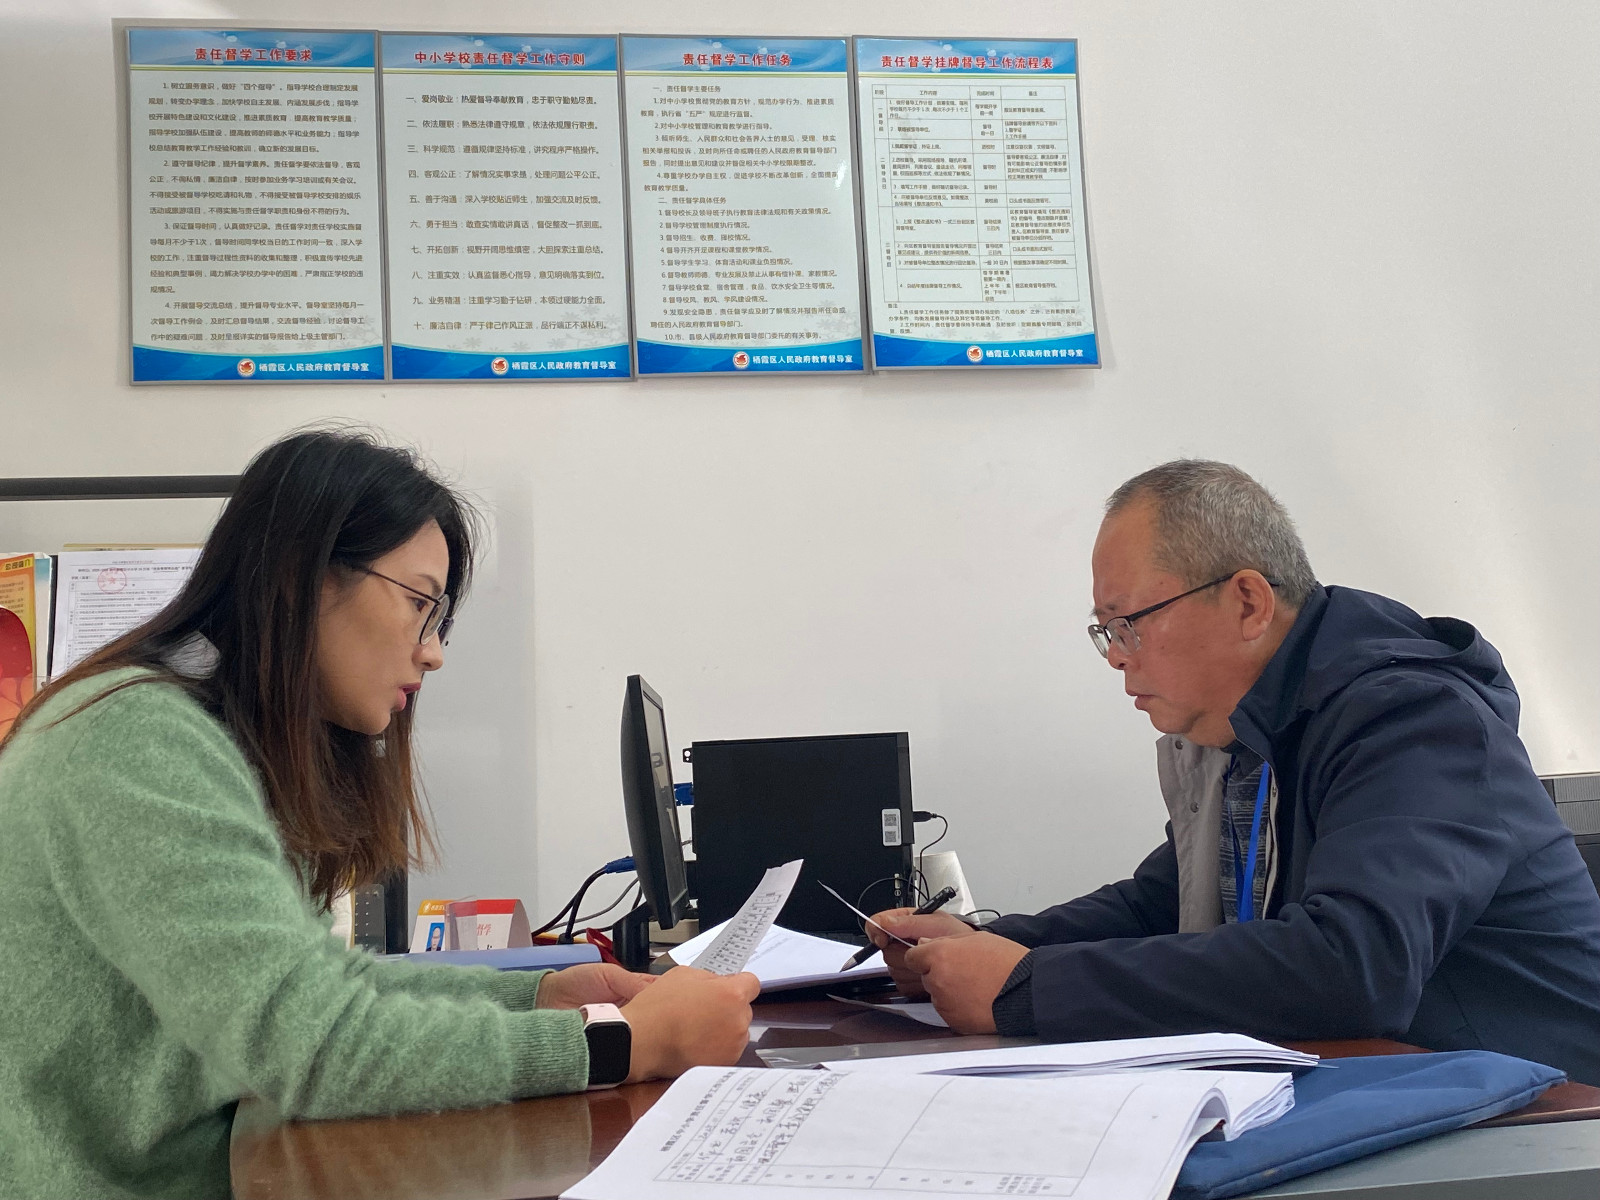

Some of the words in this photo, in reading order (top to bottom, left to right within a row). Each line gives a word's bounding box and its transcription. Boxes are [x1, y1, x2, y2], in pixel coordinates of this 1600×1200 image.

[195, 48, 312, 61] 责任督学工作要求
[415, 52, 585, 65] 中小学校责任督学工作守则
[683, 53, 792, 66] 责任督学工作任务
[881, 56, 1054, 68] 责任督学挂牌督导工作流程表
[986, 349, 1083, 357] 栖霞区人民政府教育督导室
[753, 356, 853, 364] 栖霞区人民政府教育督导室
[259, 363, 369, 372] 栖霞区人民政府教育督导室
[512, 361, 616, 370] 栖霞区人民政府教育督导室
